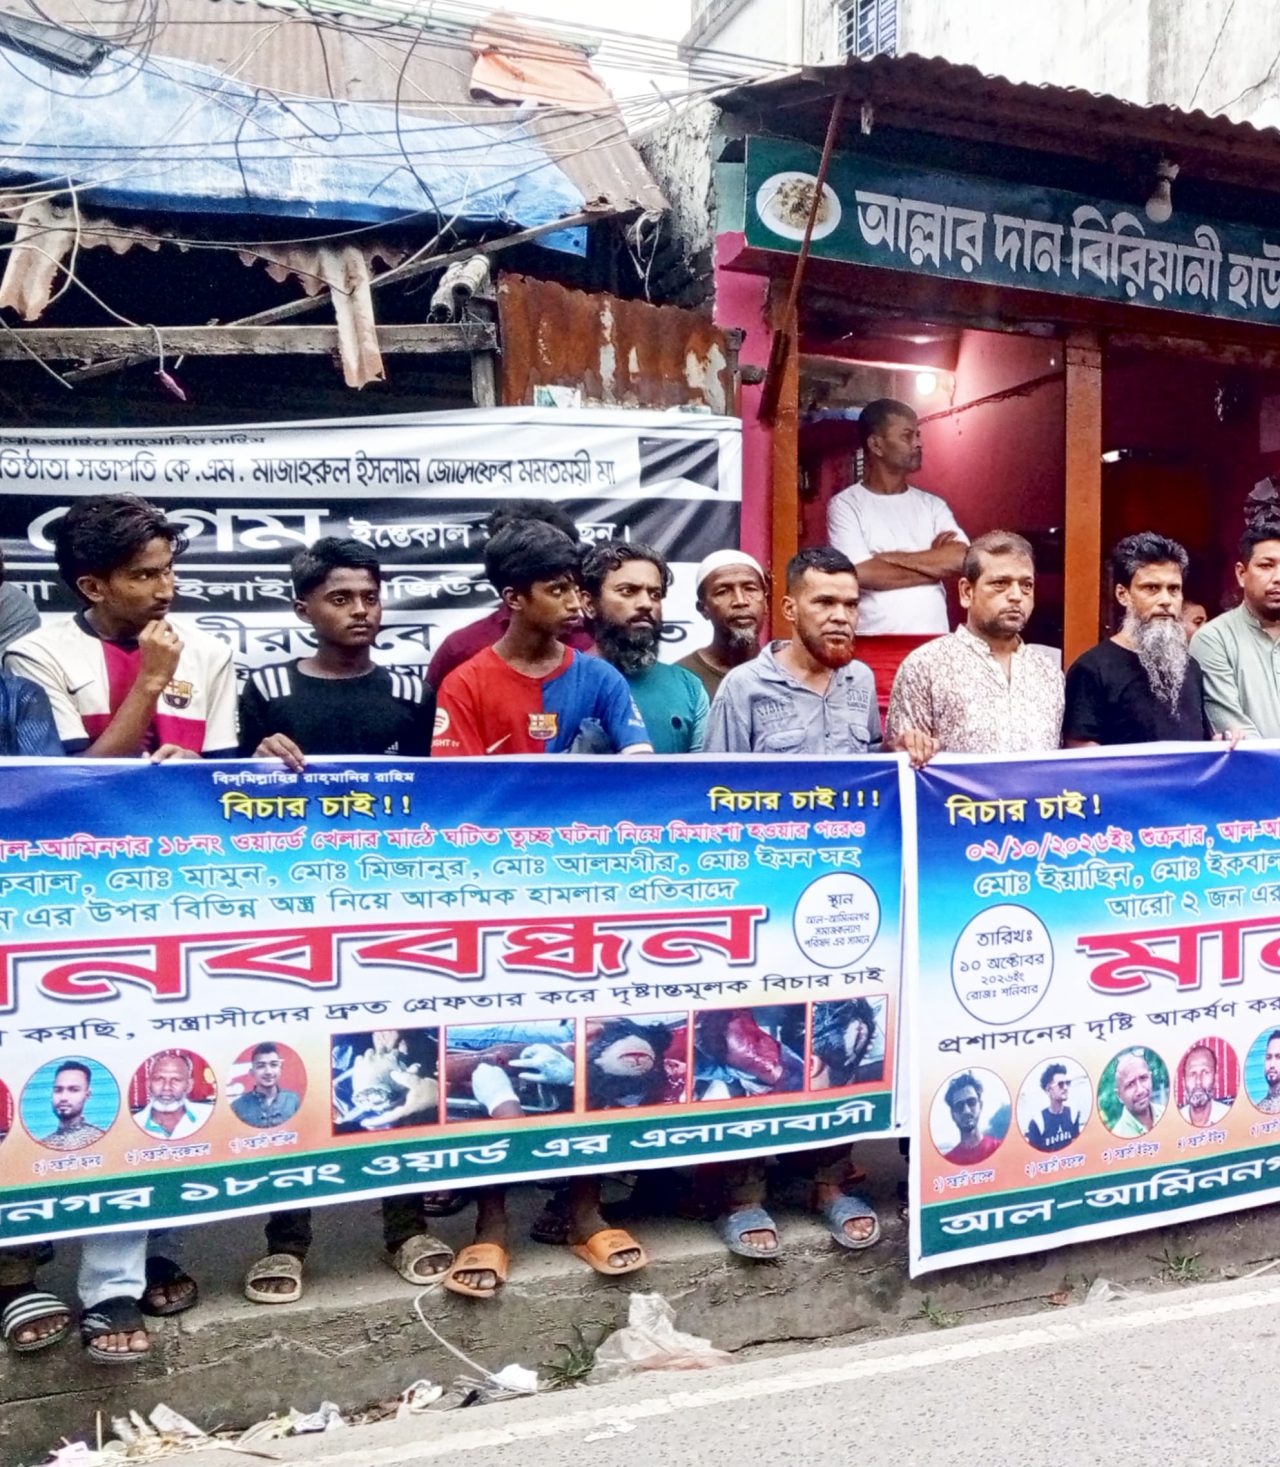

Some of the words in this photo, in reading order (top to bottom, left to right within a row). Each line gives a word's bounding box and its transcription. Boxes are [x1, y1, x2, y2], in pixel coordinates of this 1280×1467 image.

[855, 189, 984, 274] আল্লার
[994, 213, 1062, 273] দান
[1071, 205, 1224, 301] বিরিয়ানী
[0, 449, 70, 481] তিষ্ঠাতা
[76, 450, 158, 483] সভাপতি
[356, 449, 420, 487] ইসলাম
[597, 458, 617, 486] মা
[347, 515, 472, 550] ইন্তেকাল
[374, 769, 416, 784] রাহিম
[220, 790, 309, 821] বিচার
[708, 785, 782, 812] বিচার
[945, 793, 1028, 826] বিচার
[0, 831, 151, 863] ল-আমিনগর
[158, 836, 222, 858] ১৮নং
[312, 827, 379, 852] খেলার
[387, 823, 436, 849] মাঠে
[443, 823, 500, 847] ঘটিত
[508, 825, 554, 850] তুচ্ছ
[558, 822, 609, 846] ঘটনা
[616, 820, 662, 845] নিয়ে
[668, 819, 743, 844] মিমাংশা
[747, 820, 808, 842] হওয়ার
[814, 820, 865, 840] পরেও
[107, 866, 172, 892] মোঃ
[290, 860, 349, 882] মোঃ
[491, 855, 544, 876] মোঃ
[697, 851, 749, 872] মোঃ
[756, 845, 815, 870] ইমন
[820, 847, 861, 869] সহ
[973, 869, 1031, 897] মোঃ
[1151, 855, 1200, 882] মোঃ
[26, 907, 77, 928] এর
[87, 896, 158, 924] উপর
[172, 891, 257, 920] বিভিন্ন
[273, 893, 315, 914] অস্ত্র
[330, 887, 392, 912] নিয়ে
[401, 884, 518, 909] আকস্মিক
[526, 883, 620, 905] হামলার
[627, 876, 739, 902] প্রতিবাদে
[1104, 892, 1173, 919] আরো
[1181, 892, 1200, 914] ২
[1206, 886, 1244, 910] জন
[976, 925, 1033, 947] তারিখঃ
[960, 959, 982, 973] ১০
[987, 952, 1045, 970] অক্টোবর
[152, 1005, 311, 1034] সন্ত্রাসীদের
[324, 999, 392, 1022] দ্রুত
[402, 991, 523, 1013] গ্রেফতার
[538, 987, 597, 1006] করে
[611, 976, 750, 1005] দৃষ্টান্তমূলক
[762, 971, 834, 993] বিচার
[841, 966, 886, 984] চাই
[938, 1022, 1076, 1054] প্রশাসনের
[1087, 1011, 1137, 1042] দৃষ্টি
[1146, 998, 1239, 1028] আকর্ষণ
[181, 1163, 345, 1203] ১৮নং
[361, 1138, 513, 1177] ওয়ার্ড
[531, 1133, 611, 1160] এর
[629, 1101, 878, 1148] এলাকাবাসী
